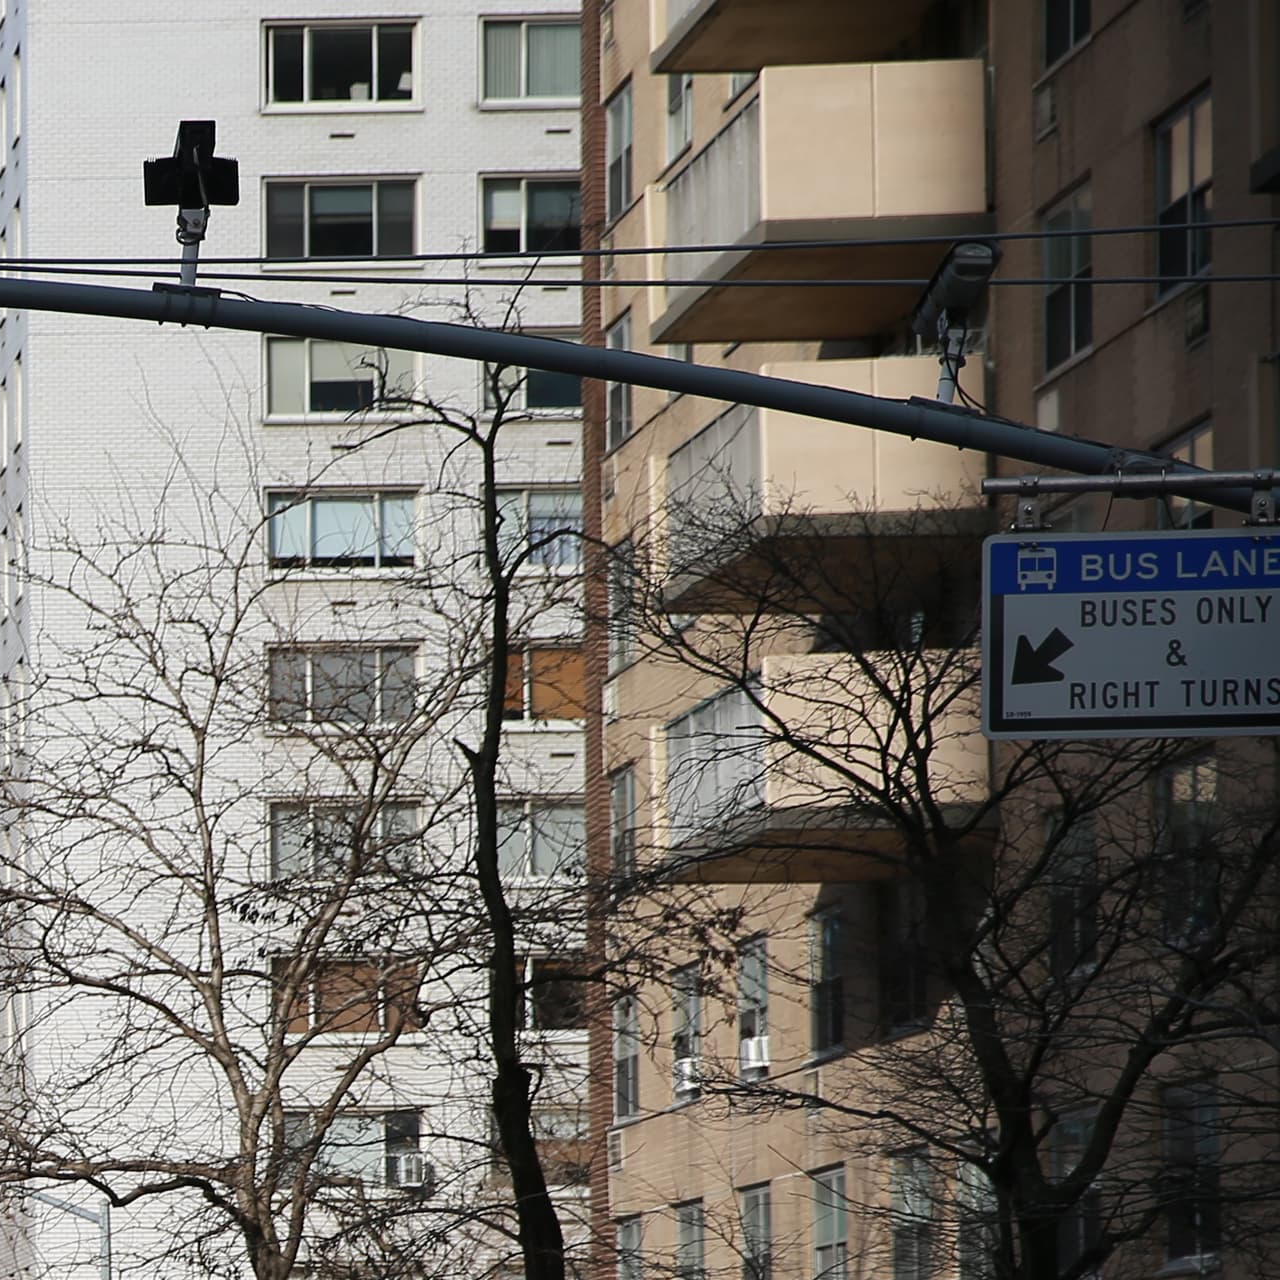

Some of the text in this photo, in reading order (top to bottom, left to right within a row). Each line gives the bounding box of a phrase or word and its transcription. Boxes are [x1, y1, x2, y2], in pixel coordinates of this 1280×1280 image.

[1080, 548, 1280, 582] BUS LANE
[1080, 595, 1273, 628] BUSES ONLY
[1165, 639, 1188, 667] &
[1069, 678, 1280, 710] RIGHT TURNS
